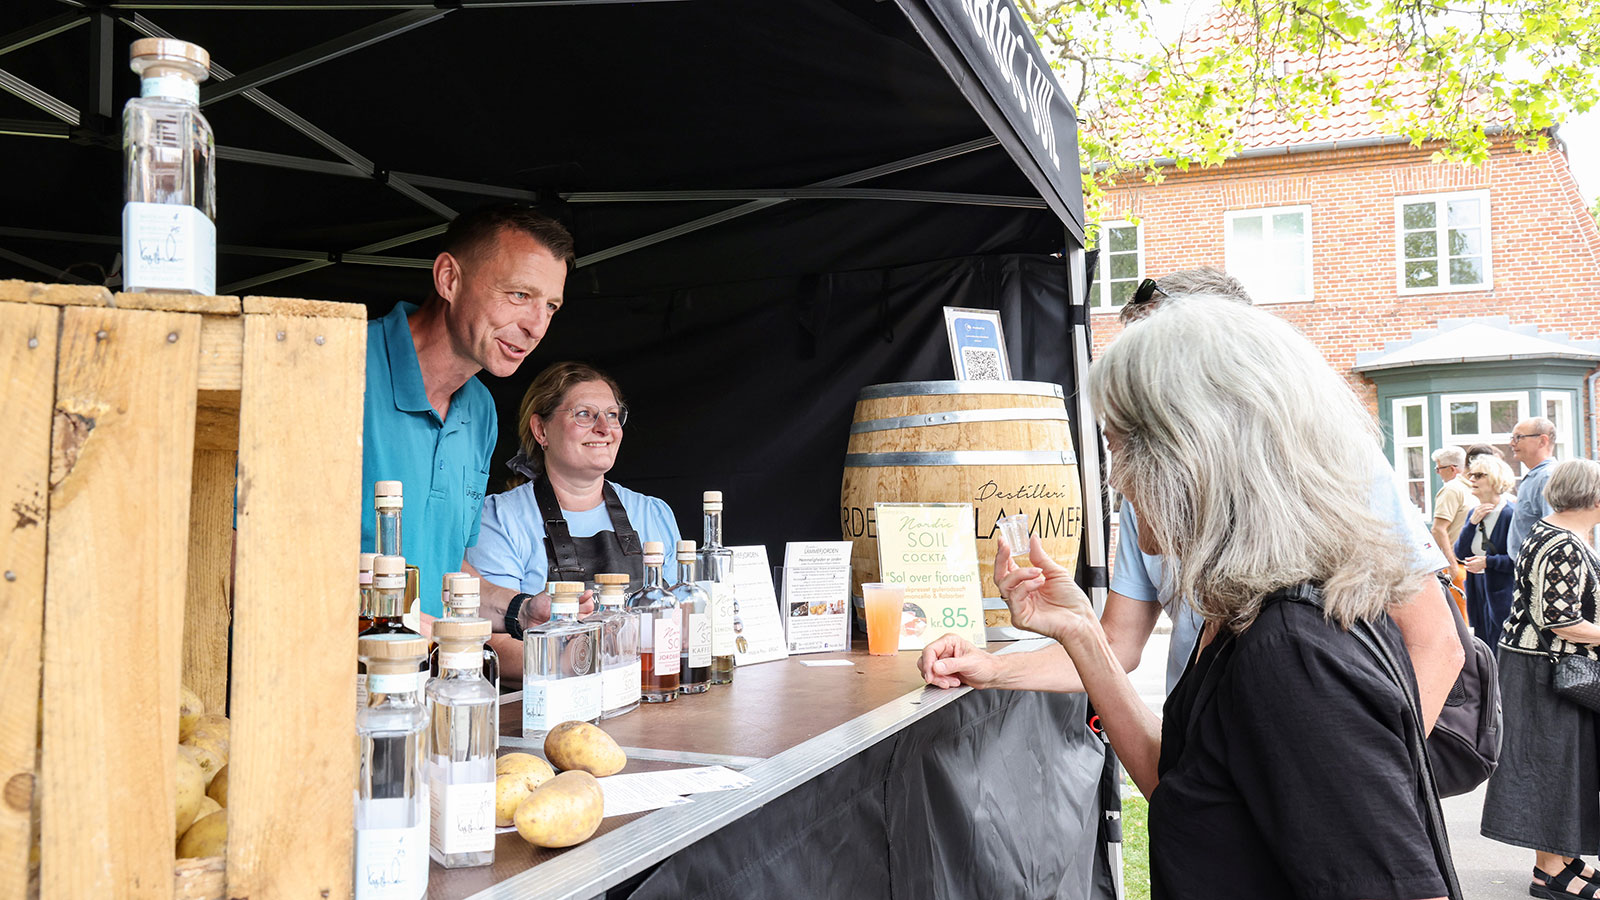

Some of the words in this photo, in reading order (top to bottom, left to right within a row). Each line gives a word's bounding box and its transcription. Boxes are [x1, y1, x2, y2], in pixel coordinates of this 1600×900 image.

[975, 479, 1066, 502] Destilleri
[899, 515, 954, 532] Nordic
[907, 532, 948, 548] SOIL
[902, 553, 948, 563] COCKTA
[910, 574, 931, 583] over
